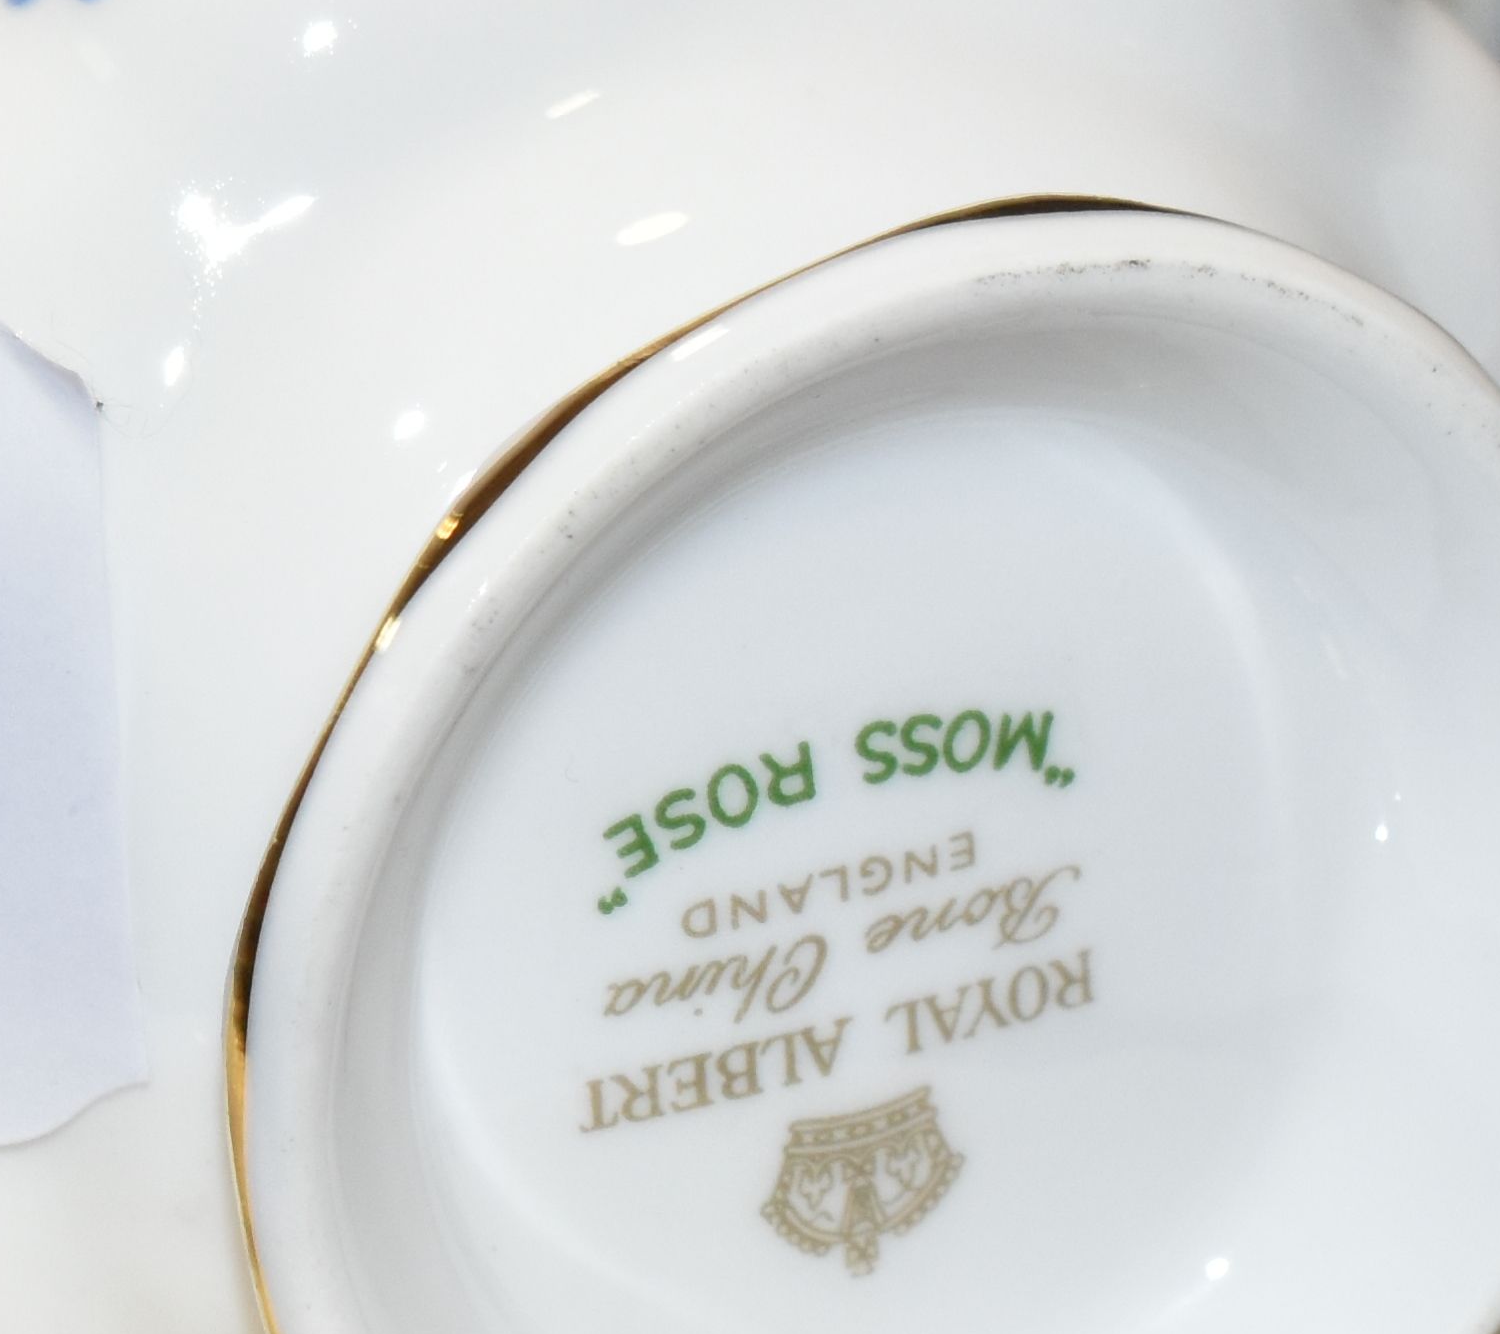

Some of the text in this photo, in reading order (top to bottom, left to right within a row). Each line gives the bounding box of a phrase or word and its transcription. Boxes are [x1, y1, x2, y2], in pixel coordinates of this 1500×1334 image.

[601, 864, 1083, 1024] Bone China
[679, 830, 977, 941] ENGLAND
[578, 948, 1096, 1134] ROYAL ALBERT
